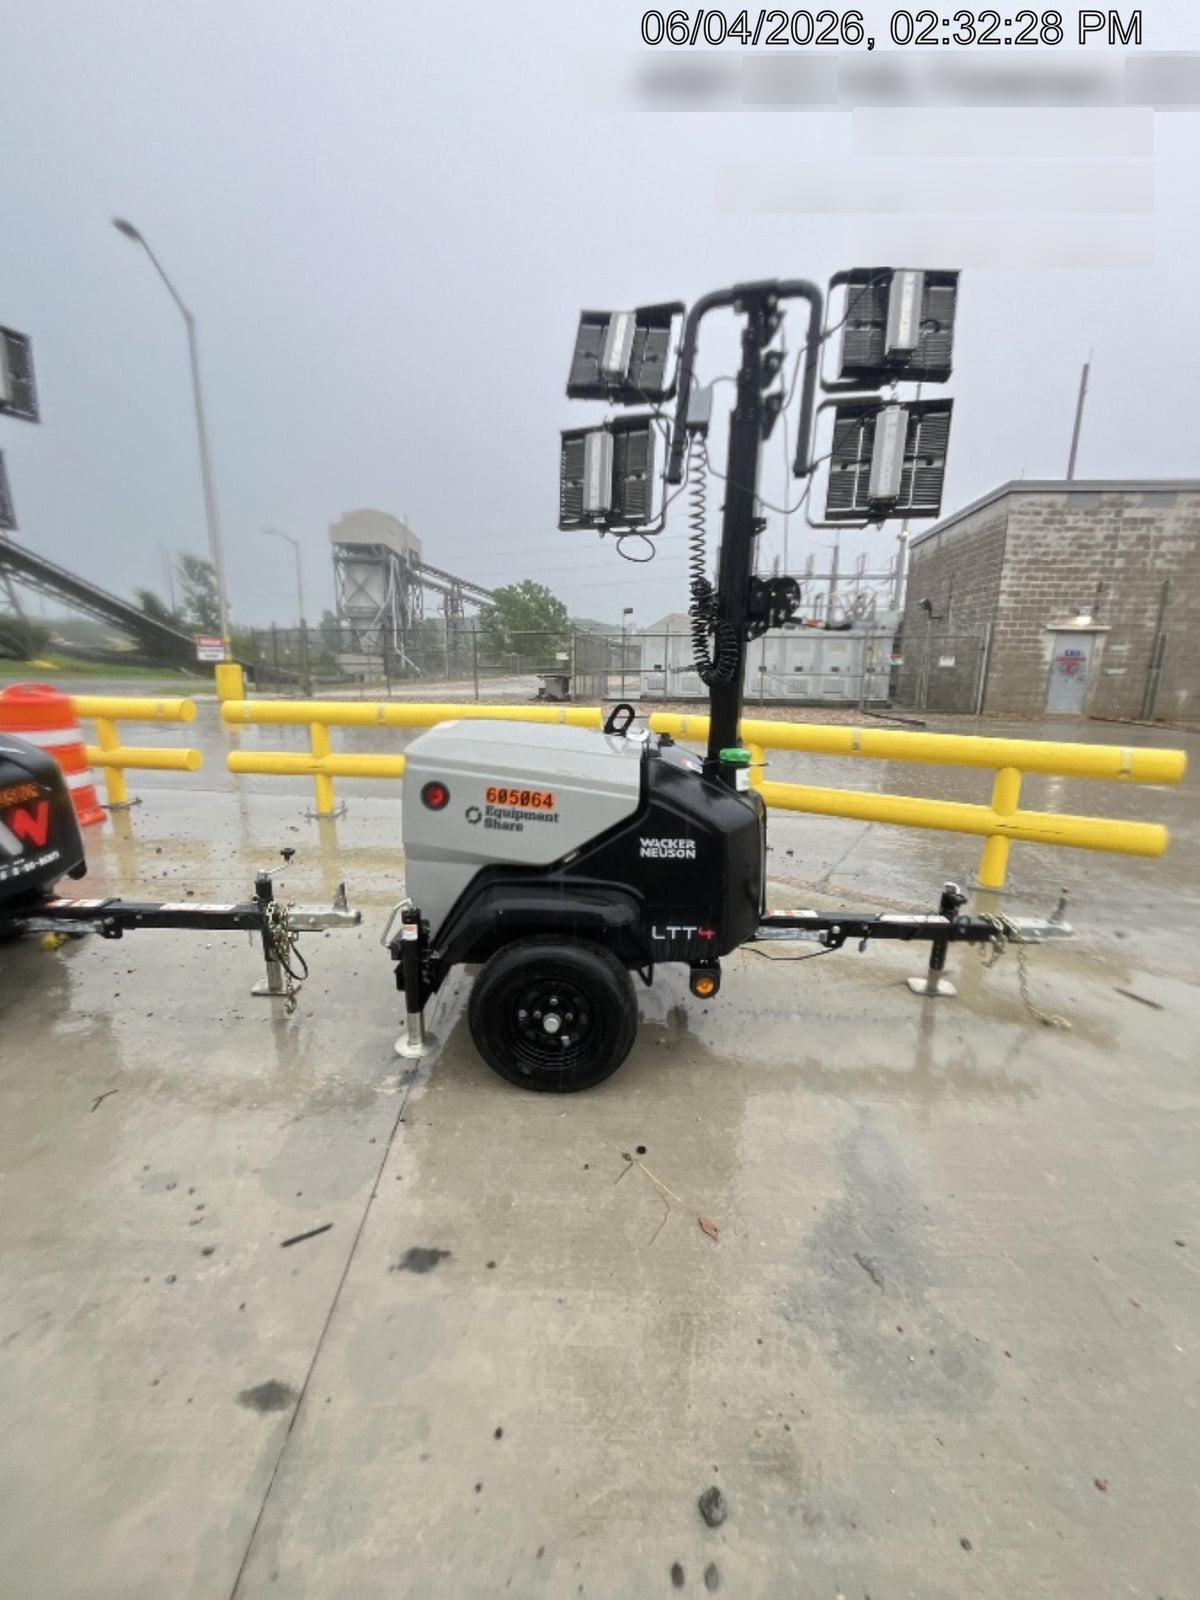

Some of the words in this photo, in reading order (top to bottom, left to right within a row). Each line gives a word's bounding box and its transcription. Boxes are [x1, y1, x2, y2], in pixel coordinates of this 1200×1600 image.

[486, 786, 554, 809] 605064
[485, 805, 560, 823] Equipment
[484, 818, 524, 832] Share
[639, 837, 696, 849] WACKER
[640, 847, 696, 859] NEUSON
[651, 925, 716, 940] LTT4
